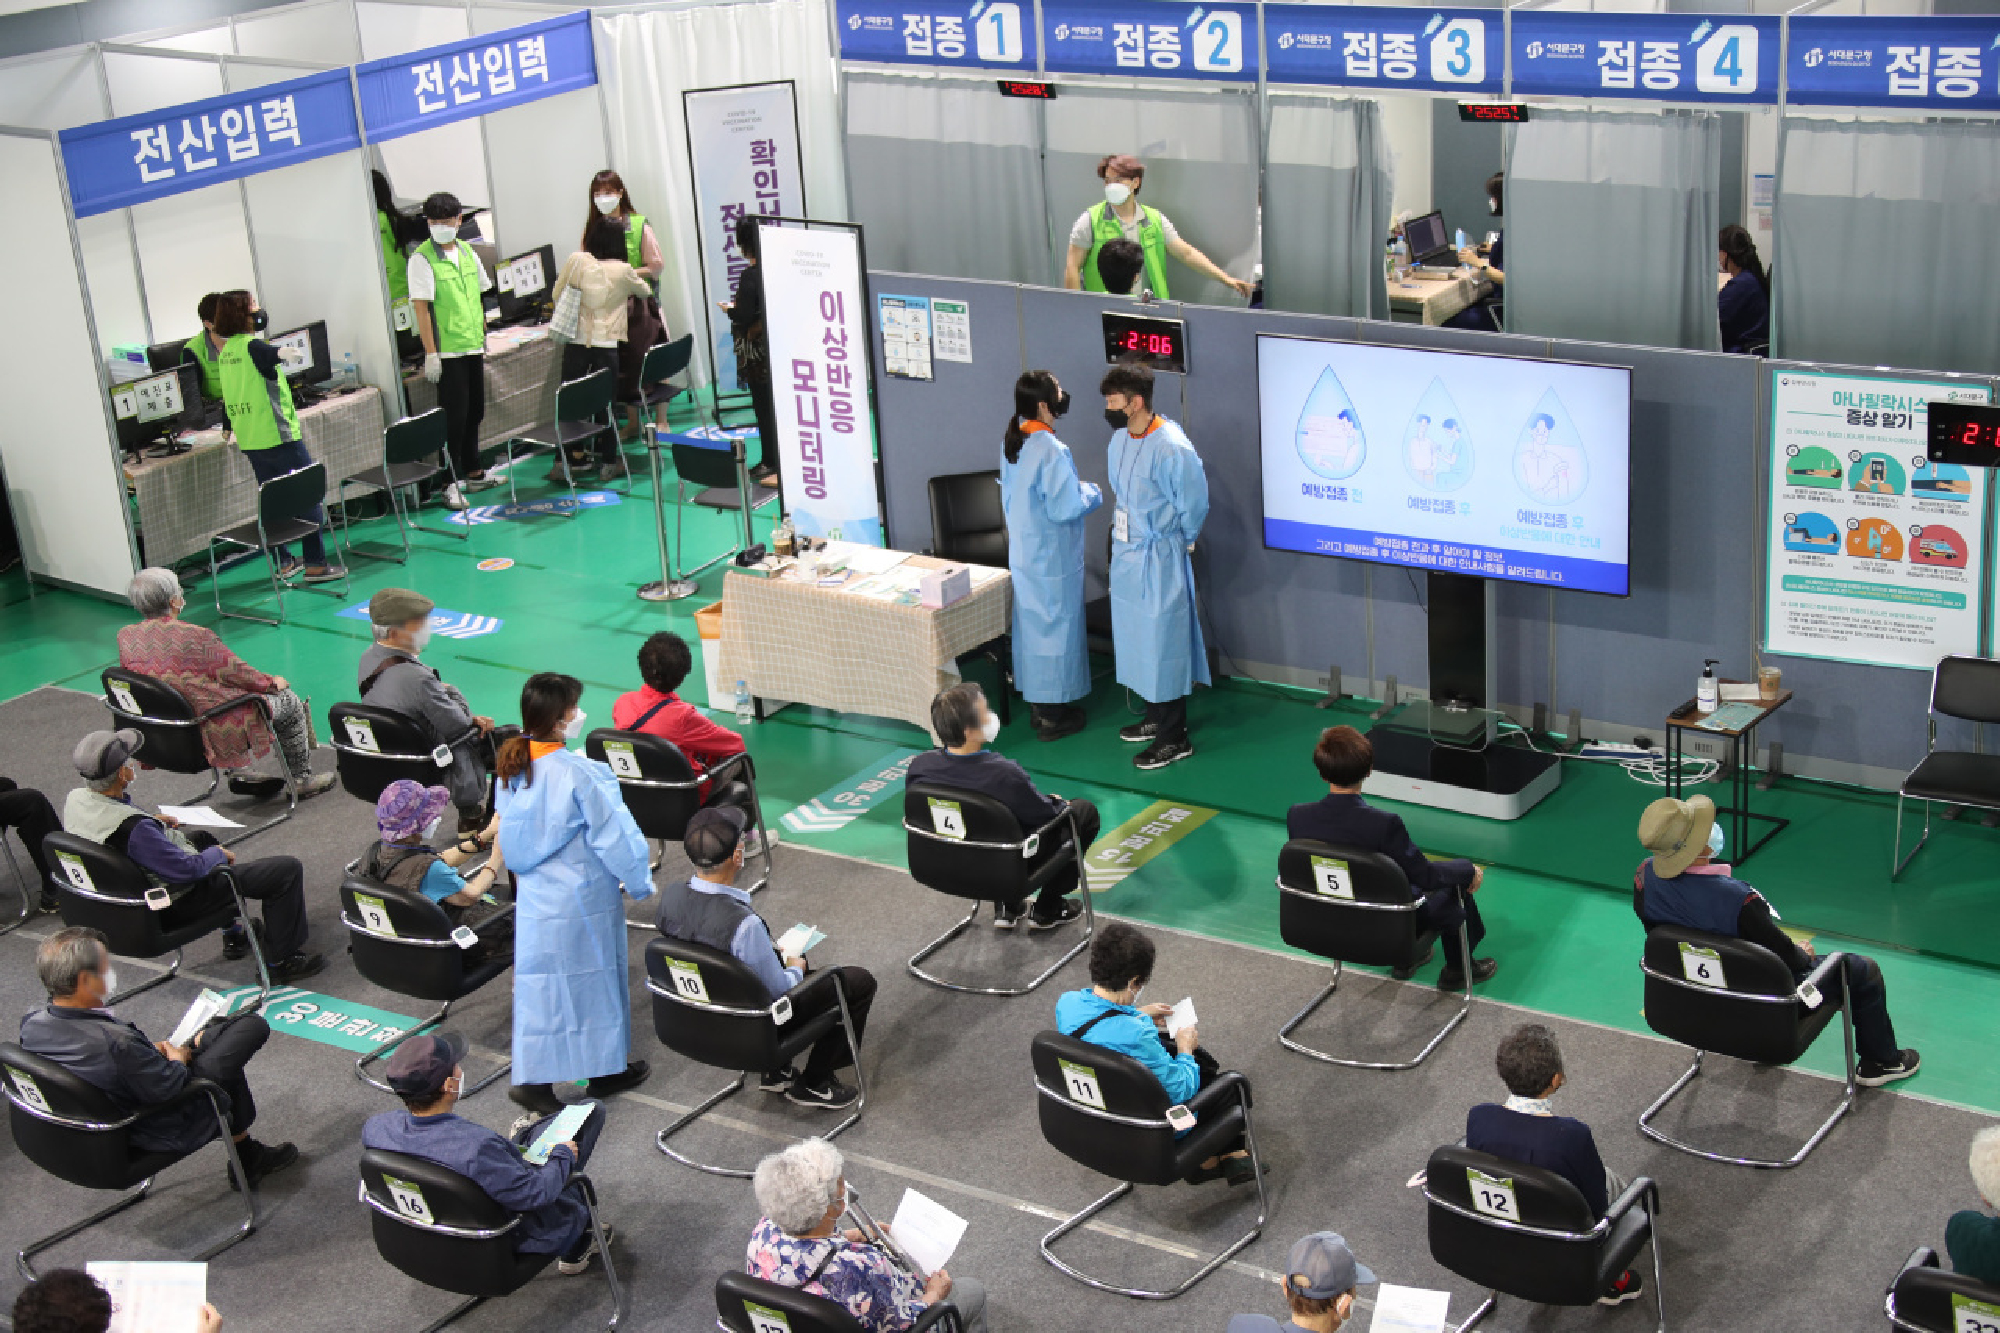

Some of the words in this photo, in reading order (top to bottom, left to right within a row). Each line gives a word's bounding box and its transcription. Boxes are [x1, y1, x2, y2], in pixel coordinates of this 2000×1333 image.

[902, 14, 966, 58] 접종
[990, 13, 1006, 56] 1
[1112, 23, 1181, 69] 접종
[1207, 20, 1231, 66] 2
[1343, 32, 1417, 79] 접종
[1446, 28, 1472, 77] 3
[1597, 40, 1682, 90] 접종
[1713, 35, 1743, 87] 4
[411, 35, 550, 115] 전산입력
[1885, 46, 1982, 98] 접종
[130, 94, 302, 184] 전산입력
[399, 312, 407, 326] 3
[1127, 330, 1173, 356] 2:06
[819, 291, 856, 434] 이상반응
[1832, 391, 1928, 413] 아나필락시스
[792, 358, 828, 500] 모니터링
[1846, 408, 1879, 428] 증상
[1882, 412, 1913, 431] 알기
[1302, 483, 1348, 502] 예방접종
[1352, 488, 1363, 504] 전
[1407, 495, 1456, 515] 예방접종
[1459, 502, 1472, 517] 후
[1516, 508, 1568, 529] 예방접종
[1572, 516, 1584, 531] 후
[1316, 539, 1342, 553] 그리고
[355, 730, 368, 745] 2
[618, 757, 631, 771] 3
[944, 816, 956, 831] 4
[71, 868, 84, 884] 8
[1327, 875, 1340, 891] 5
[369, 912, 381, 928] 9
[1697, 963, 1710, 979] 6
[679, 976, 701, 995] 10
[19, 1084, 42, 1104] 15
[1072, 1079, 1094, 1100] 11
[399, 1194, 424, 1215] 16
[1481, 1190, 1510, 1213] 12
